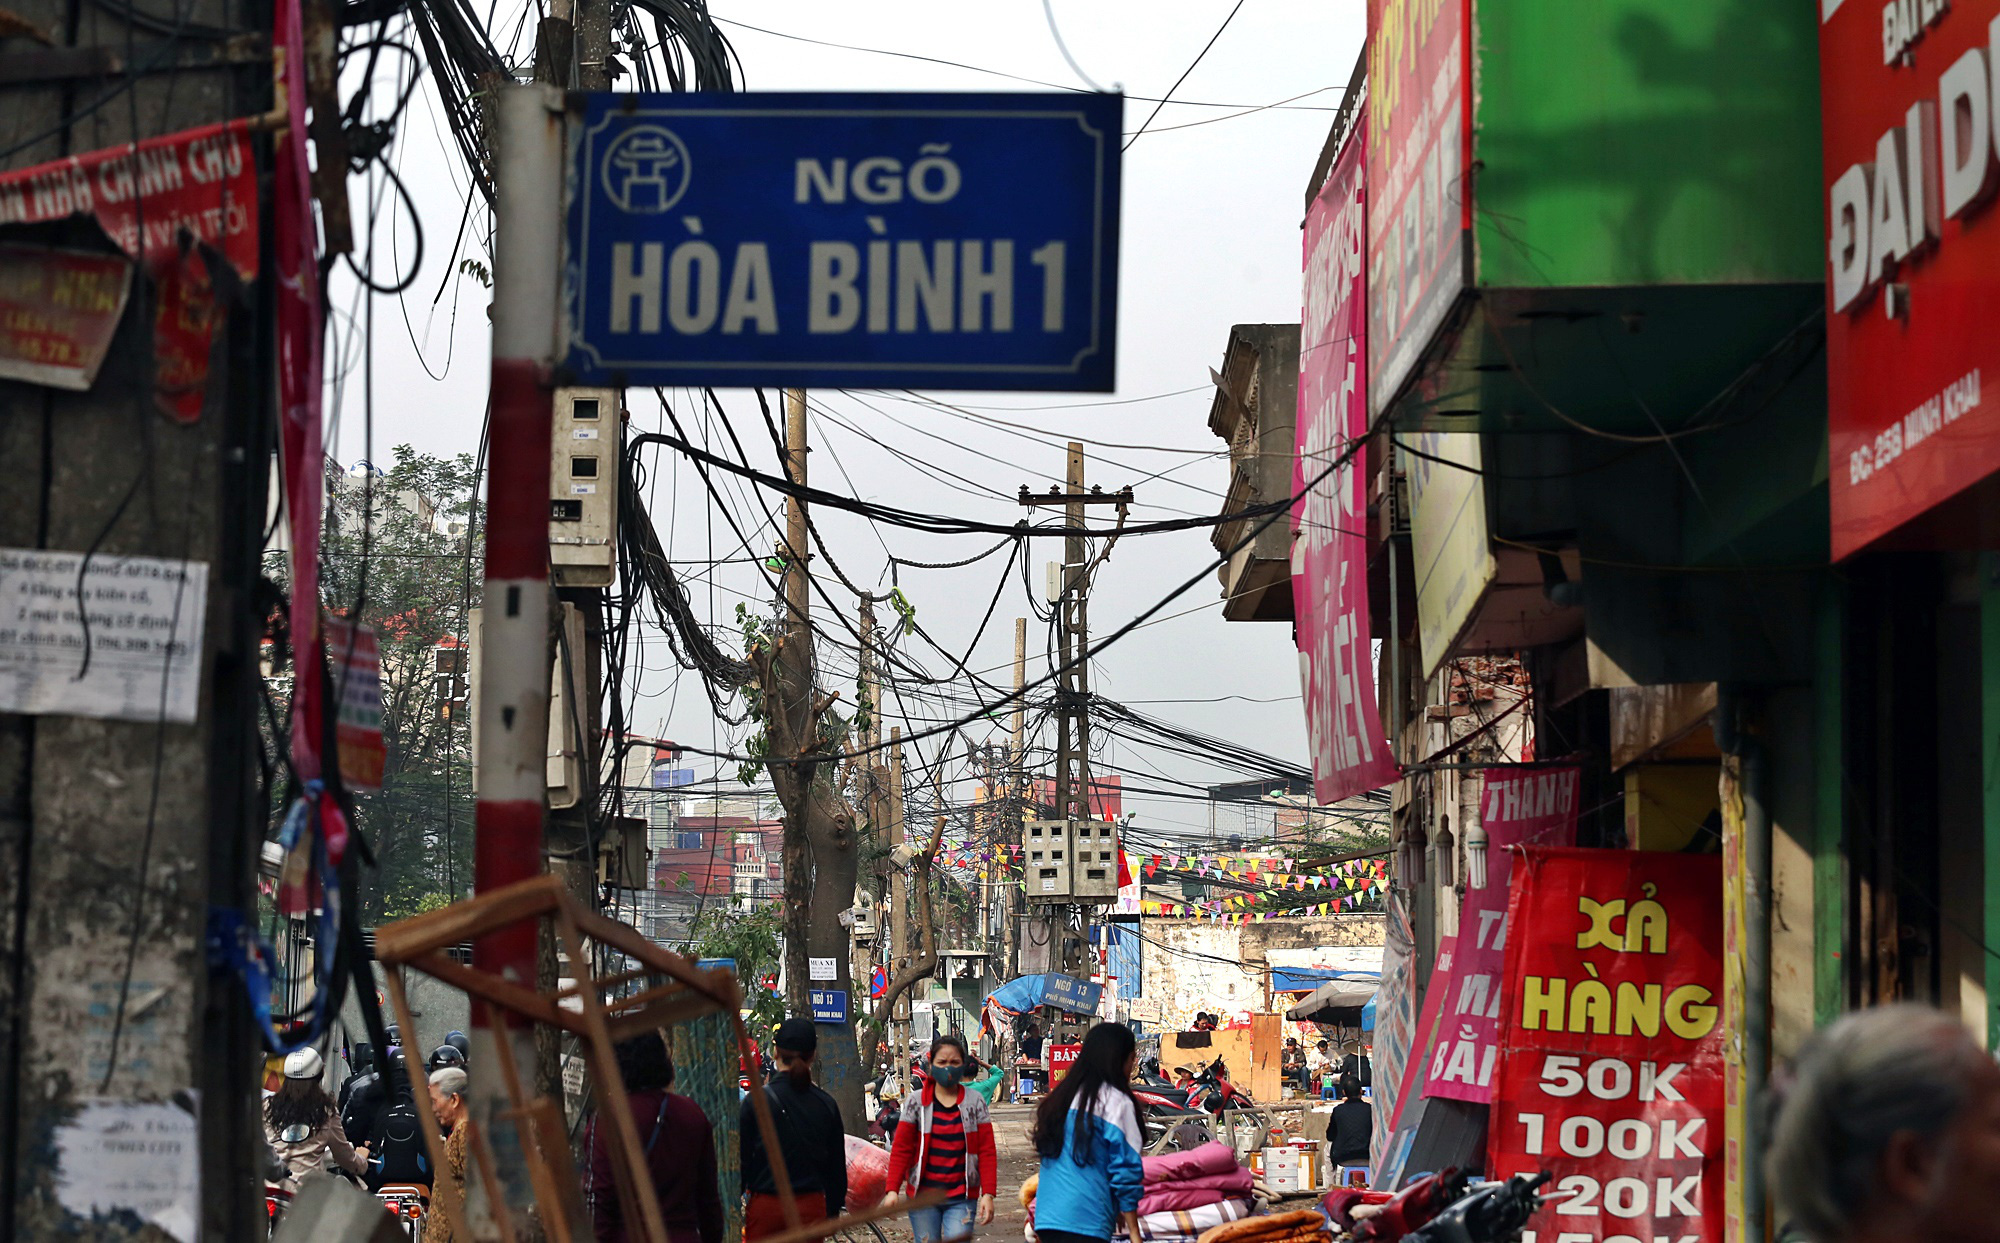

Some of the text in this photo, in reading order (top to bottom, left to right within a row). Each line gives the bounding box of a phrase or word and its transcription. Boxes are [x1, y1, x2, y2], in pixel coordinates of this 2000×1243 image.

[794, 143, 962, 204] NGÕ
[609, 216, 1067, 335] HÒA BÌNH 1
[1904, 394, 1942, 450] MINH
[1943, 367, 1981, 425] KHAI
[1485, 770, 1575, 822] THANH
[1575, 882, 1669, 955] XẢ
[826, 994, 833, 1005] 13
[1045, 991, 1092, 1011] PHỐ MINH KHAI
[1054, 978, 1088, 997] NGÕ 13
[1521, 962, 1720, 1040] HÀNG
[831, 1011, 843, 1019] KHAI
[1053, 1047, 1080, 1062] BÁN
[1538, 1055, 1688, 1102] 50K
[1518, 1113, 1708, 1160] 100K
